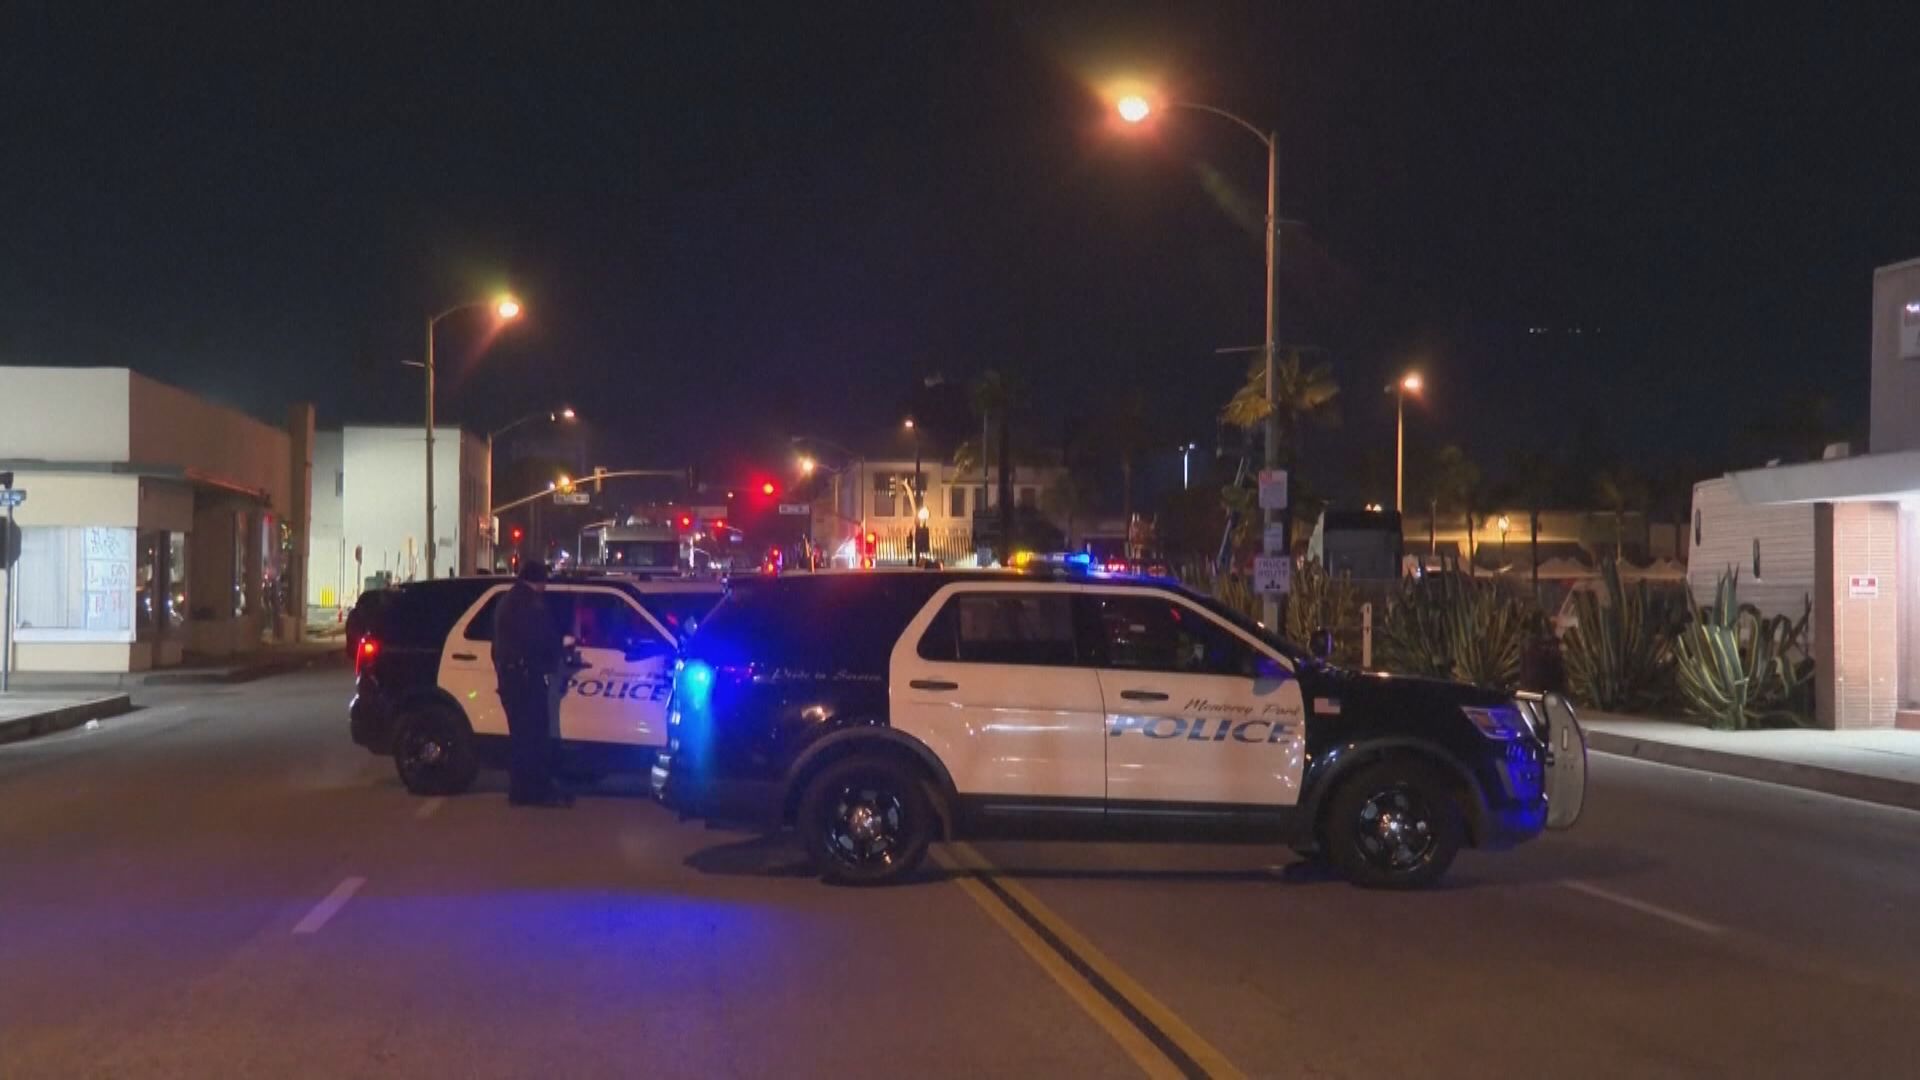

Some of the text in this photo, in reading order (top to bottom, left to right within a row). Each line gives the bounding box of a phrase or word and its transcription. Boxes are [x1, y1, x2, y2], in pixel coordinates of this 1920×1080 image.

[562, 678, 669, 701] POLICE
[1183, 697, 1300, 716] Monterey Park
[1107, 713, 1298, 744] POLICE
